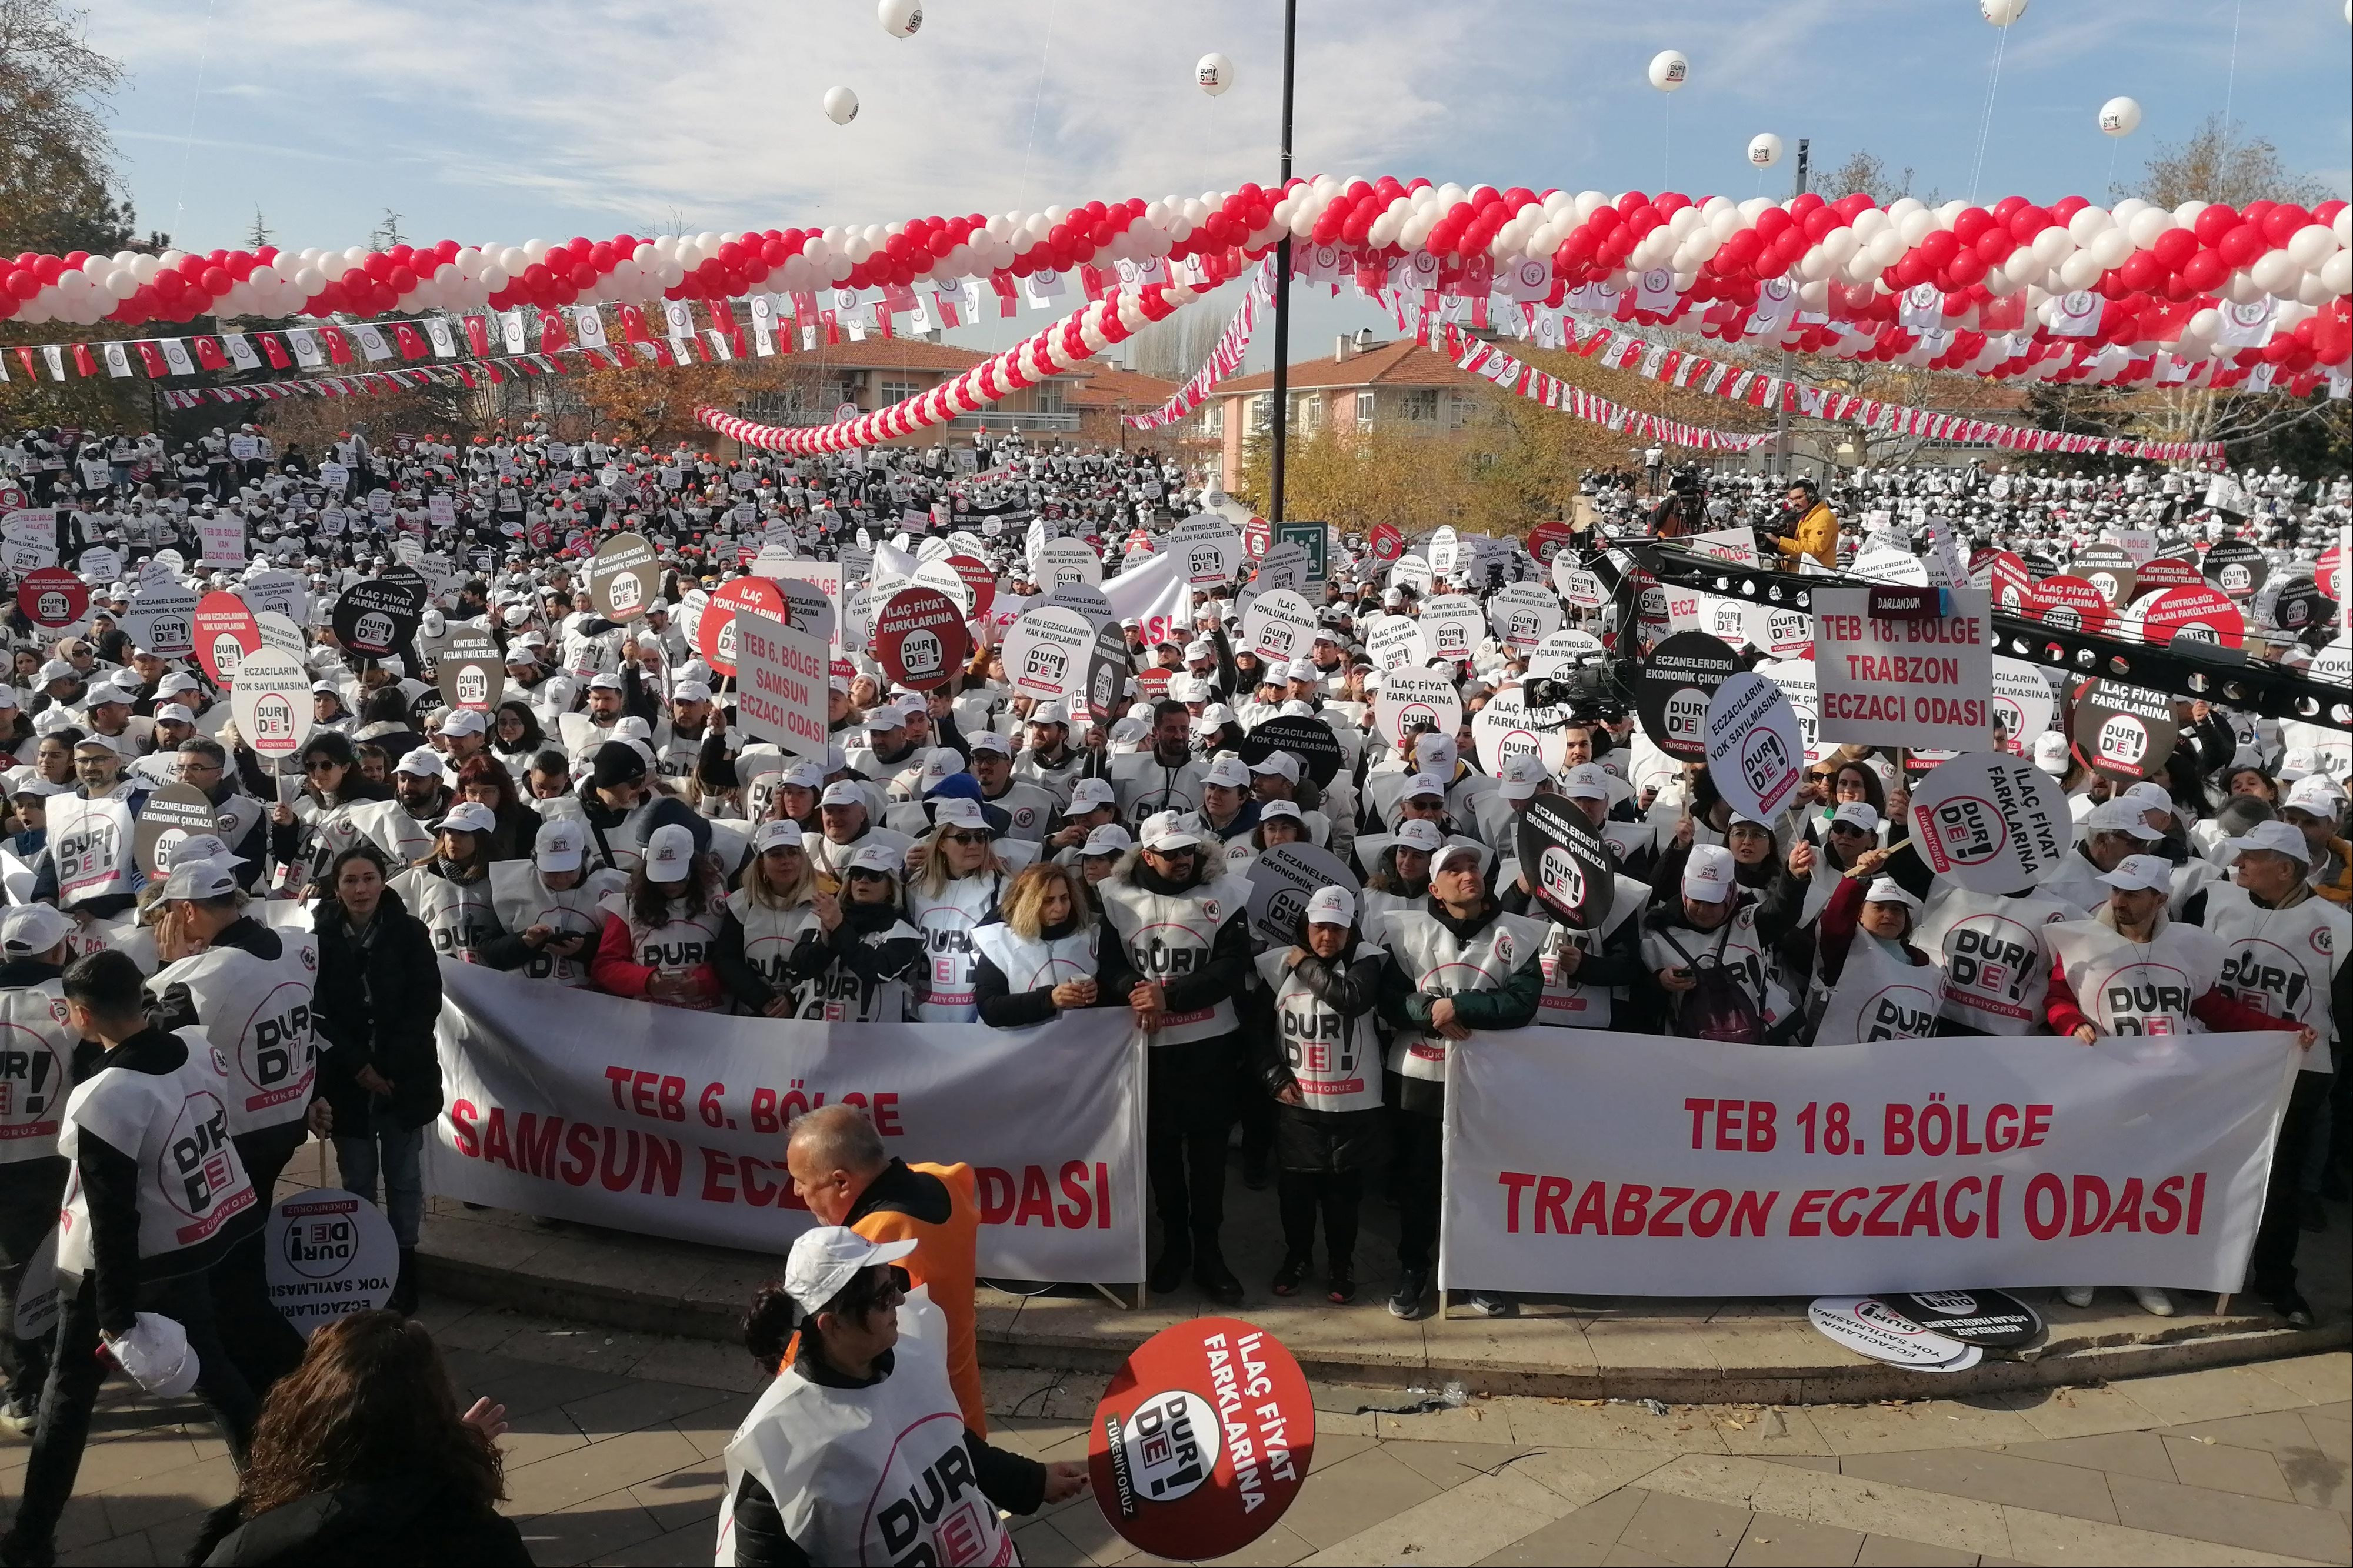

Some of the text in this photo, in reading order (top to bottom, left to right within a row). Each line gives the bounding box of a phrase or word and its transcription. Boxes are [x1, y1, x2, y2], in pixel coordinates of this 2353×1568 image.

[355, 586, 412, 606] İLAÇ FİYAT
[740, 586, 762, 604] İLAÇ
[2033, 595, 2099, 609] FARKLARINA
[2066, 583, 2096, 596] FİYAT
[2160, 594, 2214, 609] KONTROLSÜZ
[172, 606, 197, 615] ÇIKMA
[348, 597, 414, 616] FARKLARINA
[885, 597, 945, 619] İLAÇ FİYAT
[1253, 603, 1314, 629] YOKLUKLARINA
[882, 612, 954, 634] FARKLARINA
[1821, 615, 1862, 641] TEB
[1371, 629, 1417, 650] FARKLARINA
[743, 632, 820, 680] TEB 6. BÖLGE
[1655, 655, 1734, 671] ECZANELERDEKİ
[1846, 655, 1958, 685] TRABZON
[756, 668, 808, 707] SAMSUN
[1391, 677, 1422, 690] İLAÇ
[1645, 668, 1695, 682] EKONOMİK
[1386, 691, 1453, 705] FARKLARINA
[2098, 678, 2168, 705] İLAÇ FİYAT
[740, 691, 824, 745] ECZACI ODASI
[1711, 678, 1766, 736] ECZACILARIN
[1823, 693, 1986, 726] ECZACI ODASI
[2091, 693, 2172, 722] FARKLARINA
[1264, 725, 1329, 741] ECZACILARIN
[1709, 688, 1784, 763] YOK SAYILMASINA
[1250, 735, 1338, 753] YOK SAYILMASINA
[1534, 803, 1600, 853] ECZANELERDEKİ
[1986, 765, 2038, 875] FARKLARINA
[2013, 767, 2059, 860] İLAÇ FİYAT
[1525, 811, 1607, 873] EKONOMİK ÇIKMAZA
[604, 1066, 688, 1123] TEB
[699, 1081, 738, 1132] 6.
[1684, 1091, 2054, 1156] TEB 18. BÖLGE
[452, 1097, 682, 1198] SAMSUN
[975, 1161, 1111, 1229] DASI
[1497, 1170, 2208, 1243] TRABZON ECZACI ODASI
[357, 1277, 389, 1290] YOK
[1812, 1307, 1941, 1357] YOK SAYILMASINA
[1820, 1320, 1917, 1357] ECZACILARIN
[1237, 1329, 1297, 1484] İLAÇ FİYAT
[1203, 1331, 1267, 1516] FARKLARINA
